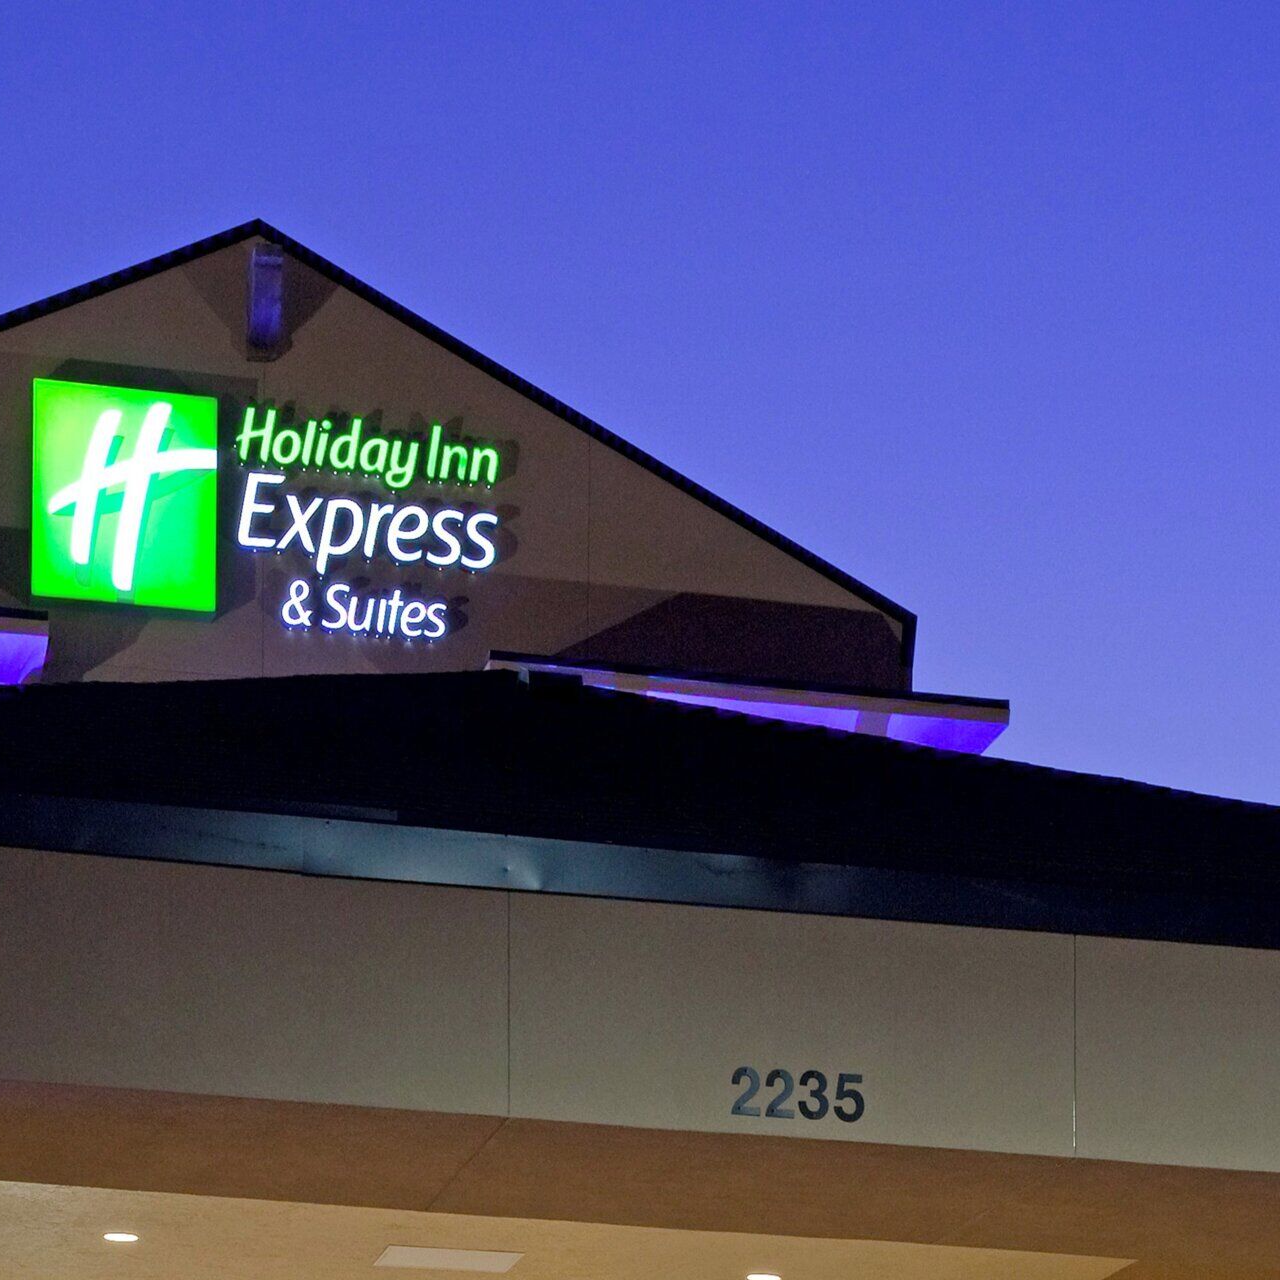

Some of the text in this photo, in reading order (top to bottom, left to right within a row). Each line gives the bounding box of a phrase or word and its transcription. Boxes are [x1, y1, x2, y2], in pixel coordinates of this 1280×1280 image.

[235, 406, 499, 489] Holiday Inn
[237, 472, 498, 576] Express
[281, 579, 447, 638] & Suites
[730, 1066, 866, 1123] 2235
